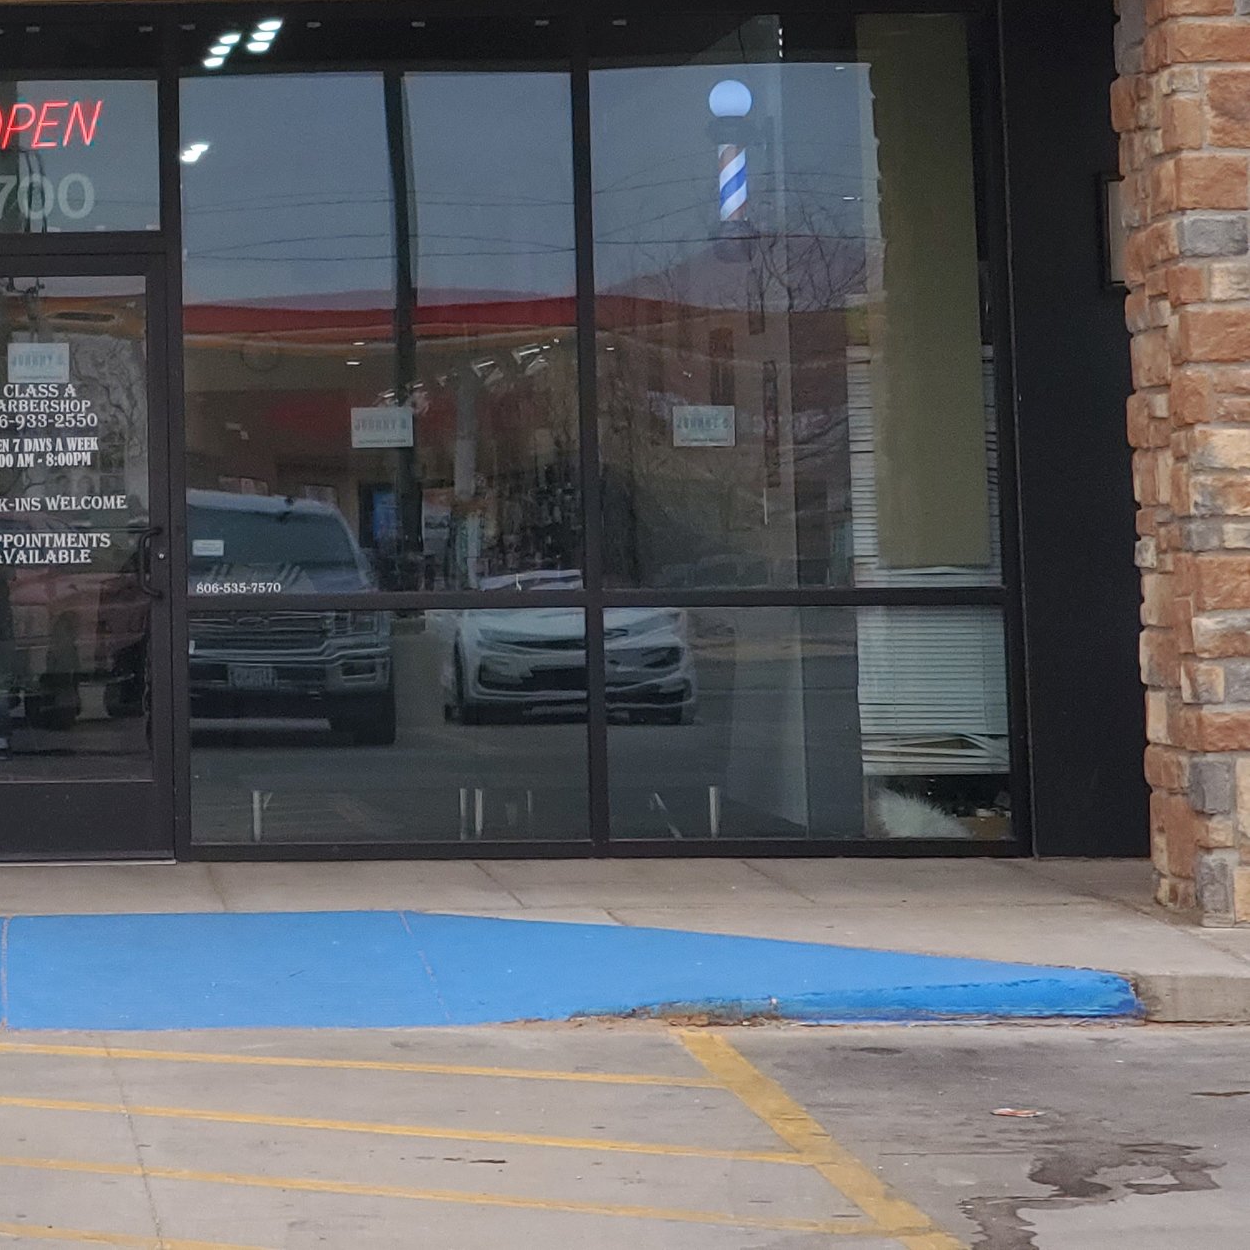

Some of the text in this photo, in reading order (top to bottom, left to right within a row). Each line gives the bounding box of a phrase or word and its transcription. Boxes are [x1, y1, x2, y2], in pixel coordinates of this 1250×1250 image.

[2, 383, 77, 399] CLASS A
[13, 438, 20, 452] 7
[24, 437, 52, 453] DAYS
[55, 437, 64, 452] A
[66, 436, 99, 452] WEEK
[17, 453, 35, 468] AM
[45, 452, 92, 467] 8:00PM
[45, 495, 128, 511] WELCOME
[196, 582, 282, 594] 806-535-7570
